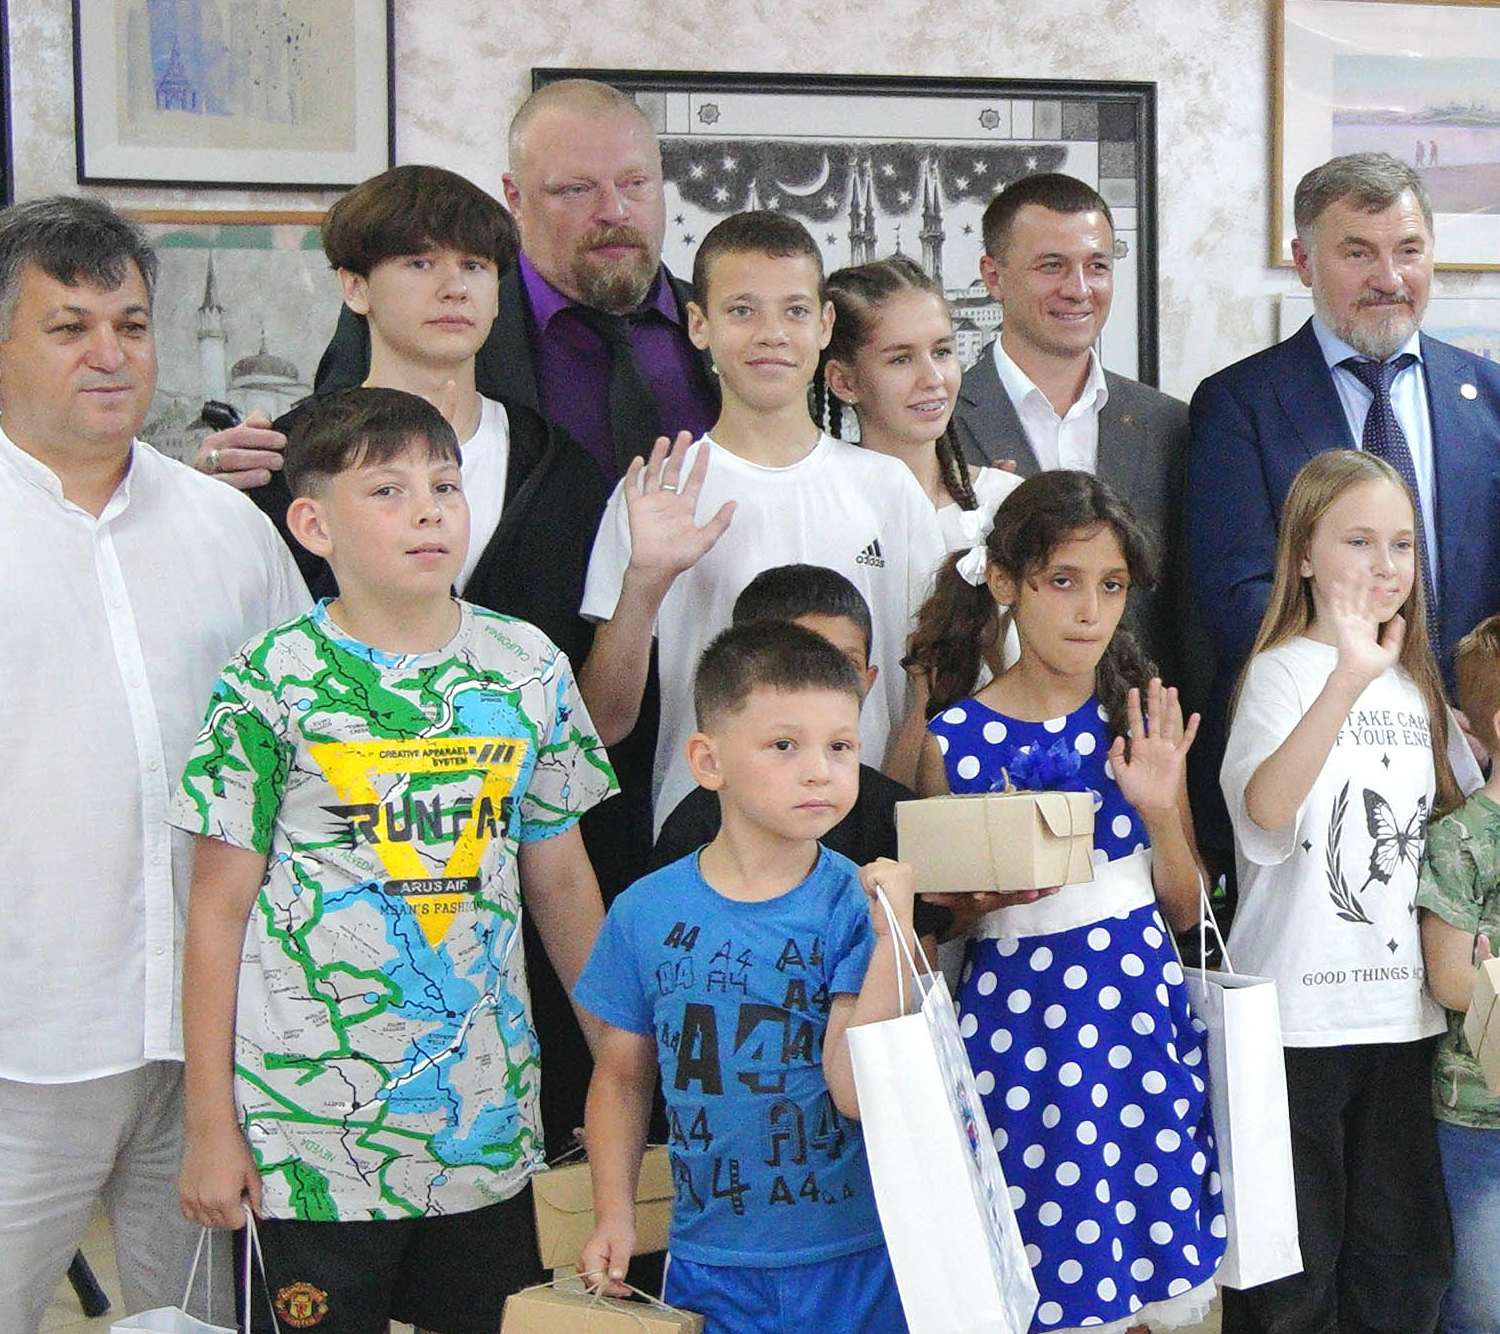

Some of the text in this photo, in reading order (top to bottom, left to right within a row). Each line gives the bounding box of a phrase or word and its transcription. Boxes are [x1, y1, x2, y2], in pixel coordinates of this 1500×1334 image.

[1347, 709, 1429, 732] TAKE CAR
[1350, 727, 1398, 746] YOUR
[319, 794, 514, 850] RUN FAS
[401, 881, 443, 893] ARUS
[663, 922, 701, 952] A4
[1302, 971, 1346, 986] GOOD
[1351, 966, 1409, 983] THINGS
[769, 1172, 821, 1205] A4
